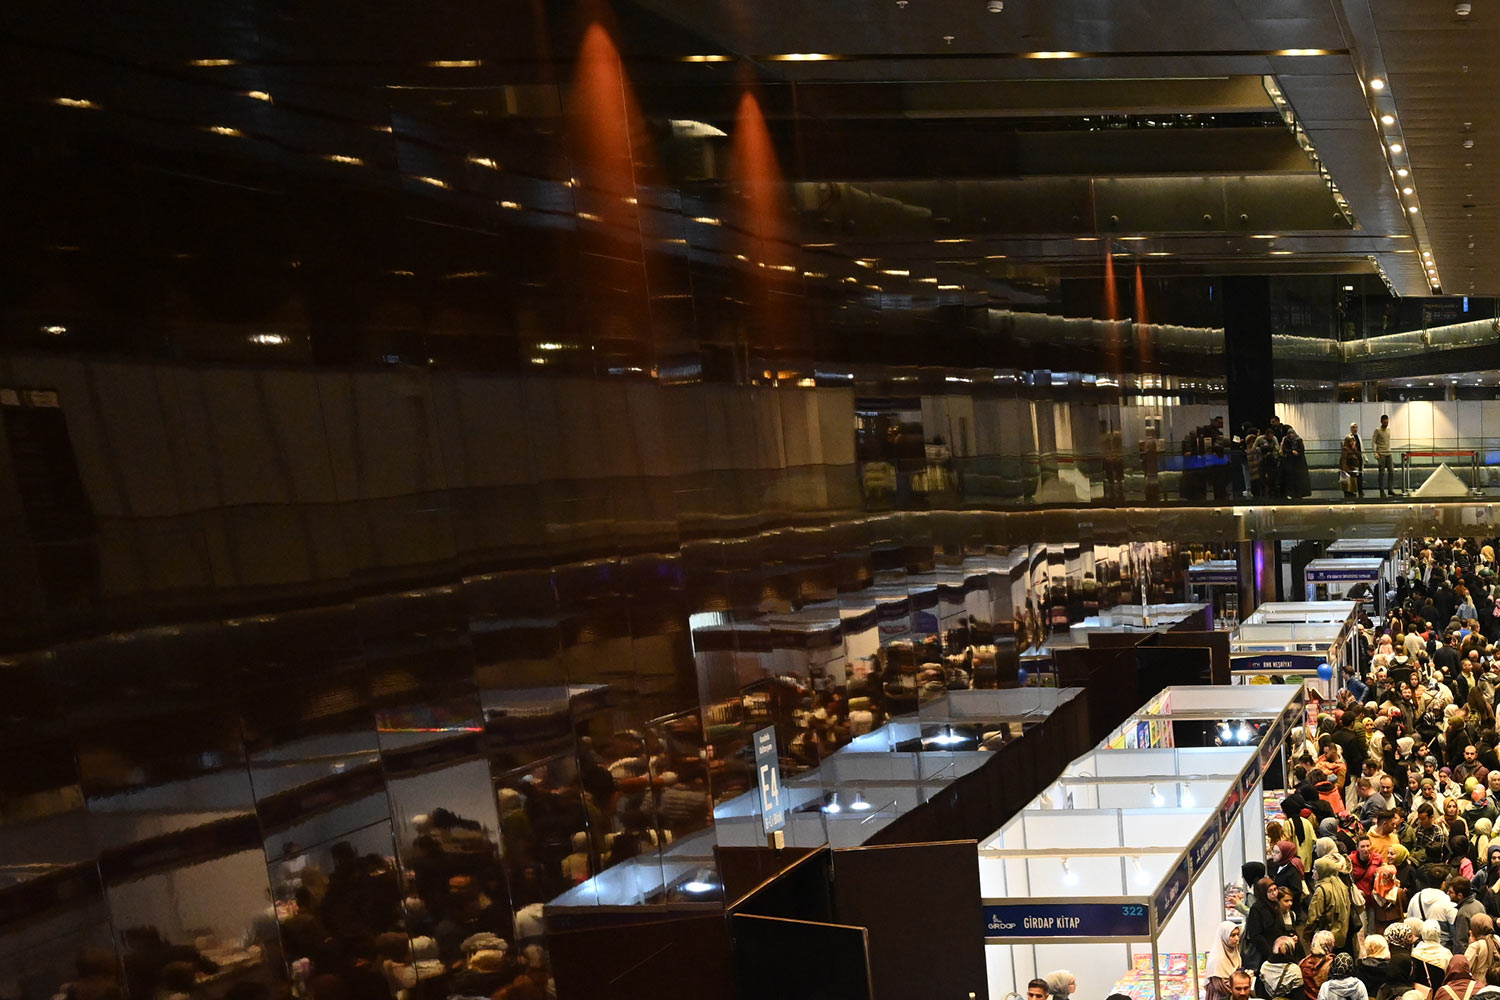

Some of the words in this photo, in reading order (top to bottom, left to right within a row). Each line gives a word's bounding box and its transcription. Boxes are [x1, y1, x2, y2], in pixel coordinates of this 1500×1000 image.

[760, 764, 779, 811] E4
[1122, 906, 1144, 916] 322
[1023, 915, 1054, 929] GİRDAP
[1056, 915, 1081, 929] KİTAP
